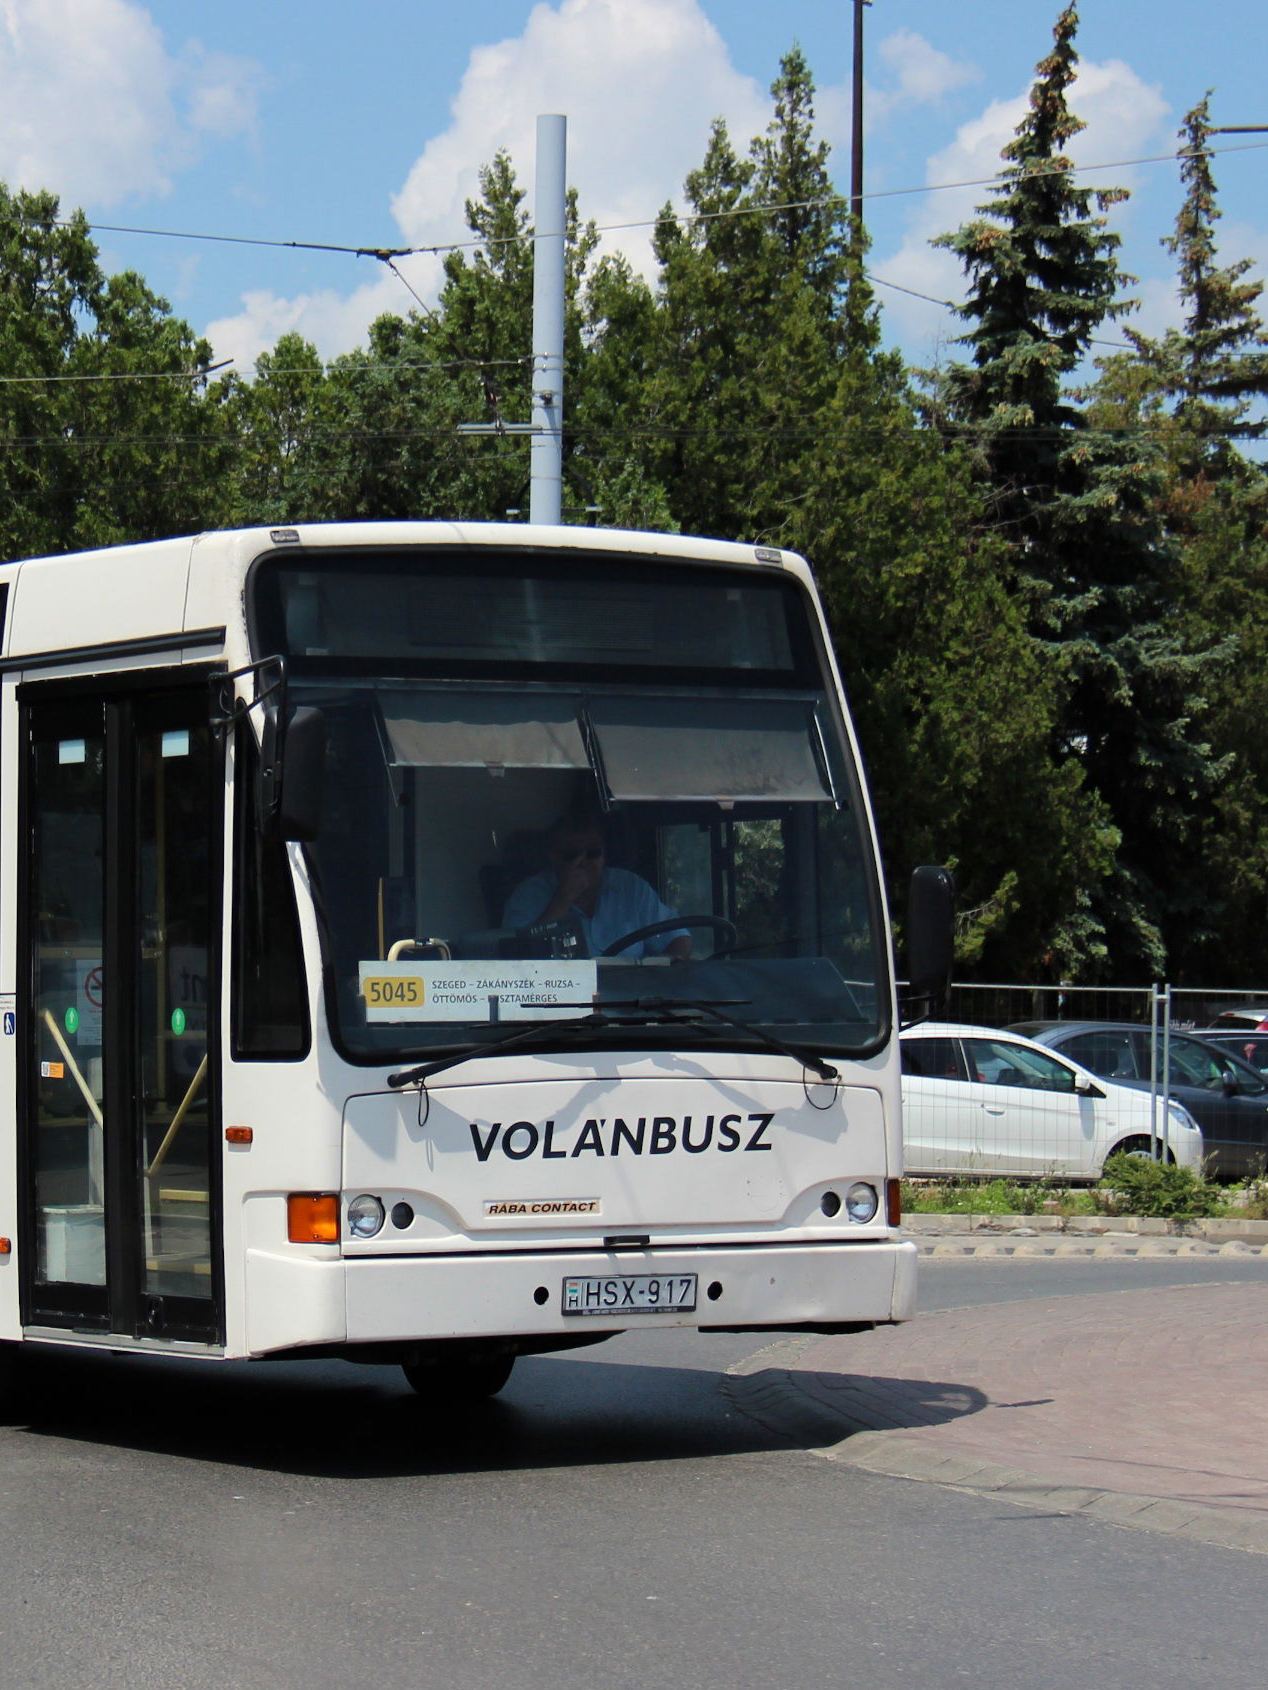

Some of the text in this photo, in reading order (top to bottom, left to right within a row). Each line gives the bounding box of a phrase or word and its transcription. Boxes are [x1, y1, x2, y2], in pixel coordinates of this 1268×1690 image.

[432, 980, 467, 989] SZEGED
[476, 978, 535, 989] ZÁKÁNYSZÉK
[544, 979, 574, 989] RUZSA
[370, 982, 418, 1003] 5045
[488, 993, 558, 1004] SZTAMÉRGES
[469, 1113, 775, 1162] VOLÁNBUSZ
[531, 1202, 596, 1213] CONTACT
[568, 1279, 692, 1307] H HSX-917
